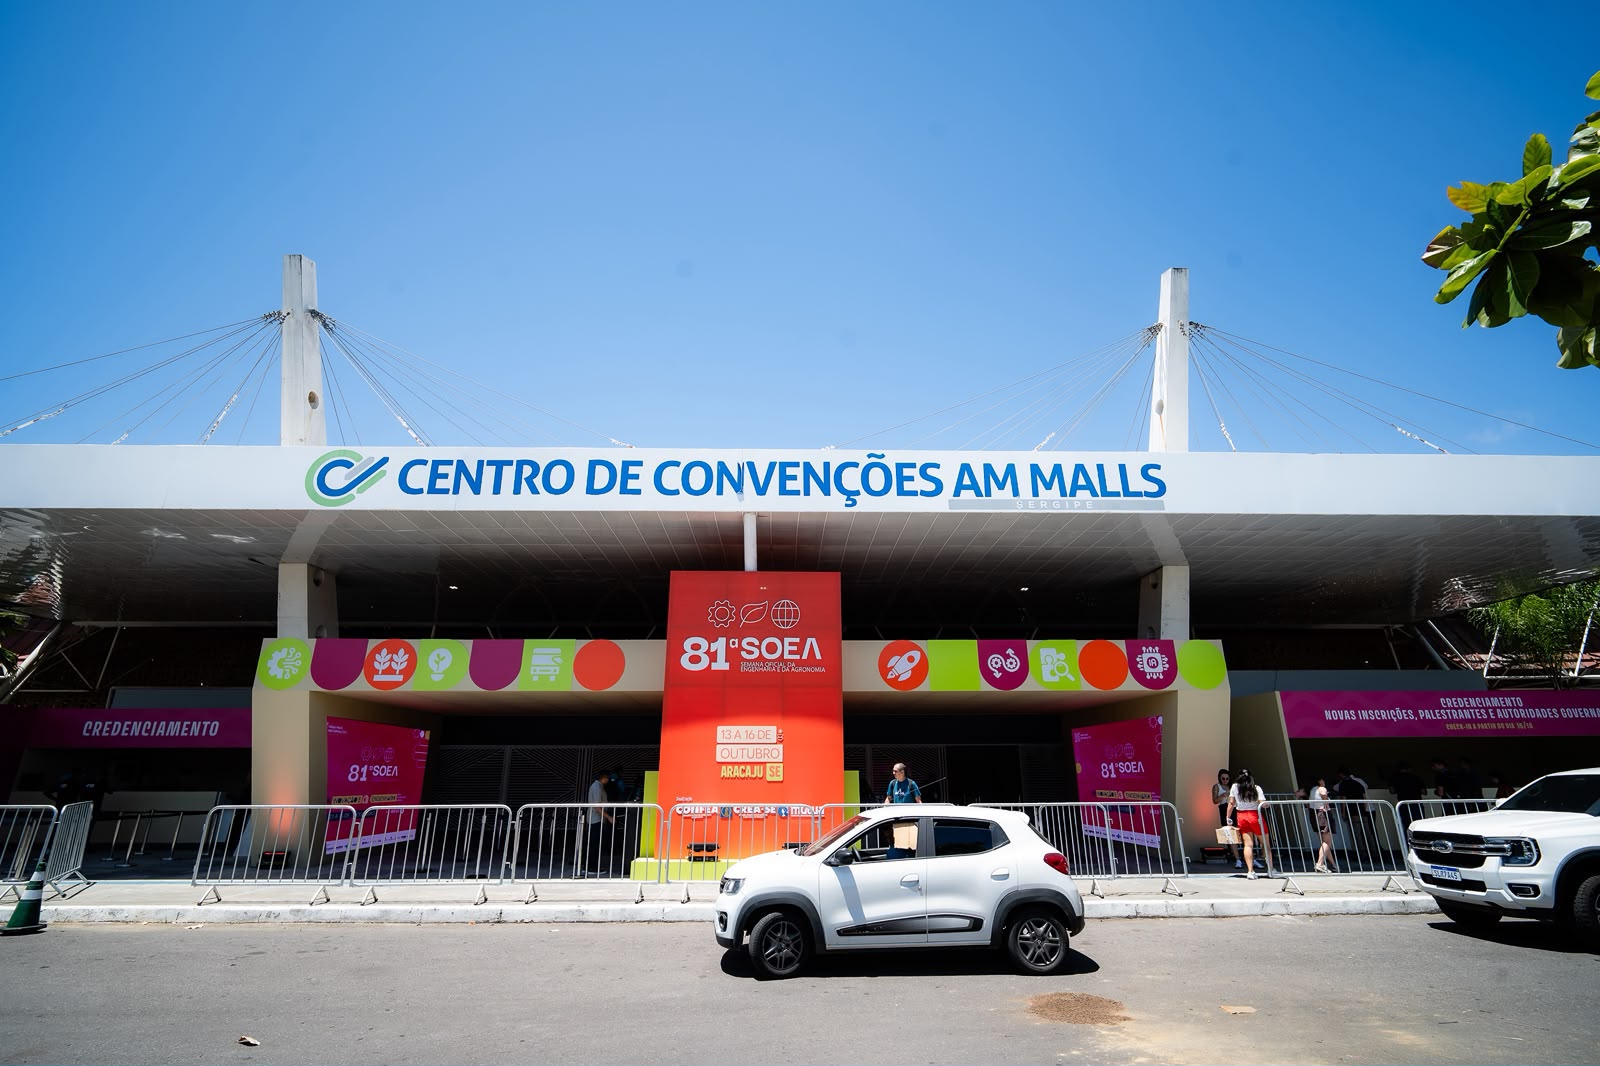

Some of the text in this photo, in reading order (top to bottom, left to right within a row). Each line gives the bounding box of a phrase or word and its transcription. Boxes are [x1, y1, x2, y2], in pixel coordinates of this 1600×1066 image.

[398, 452, 1167, 508] CENTRO DE CONVENÇÕES AM MALLS
[1016, 500, 1094, 509] SERGIPE
[740, 637, 822, 660] SOEA
[1440, 697, 1523, 708] CREDENCIAMENTO
[1324, 709, 1356, 720] NOVAS
[1358, 707, 1418, 722] INSCRIÇÕES,
[1418, 709, 1488, 720] PALESTRANTES
[1488, 709, 1495, 719] E
[1496, 708, 1559, 719] AUTORIDADES
[82, 720, 220, 737] CREDENCIAMENTO
[721, 729, 772, 740] 13 A 16 DE
[720, 747, 780, 760] OUTUBRO
[720, 765, 781, 778] ARACAJU SE
